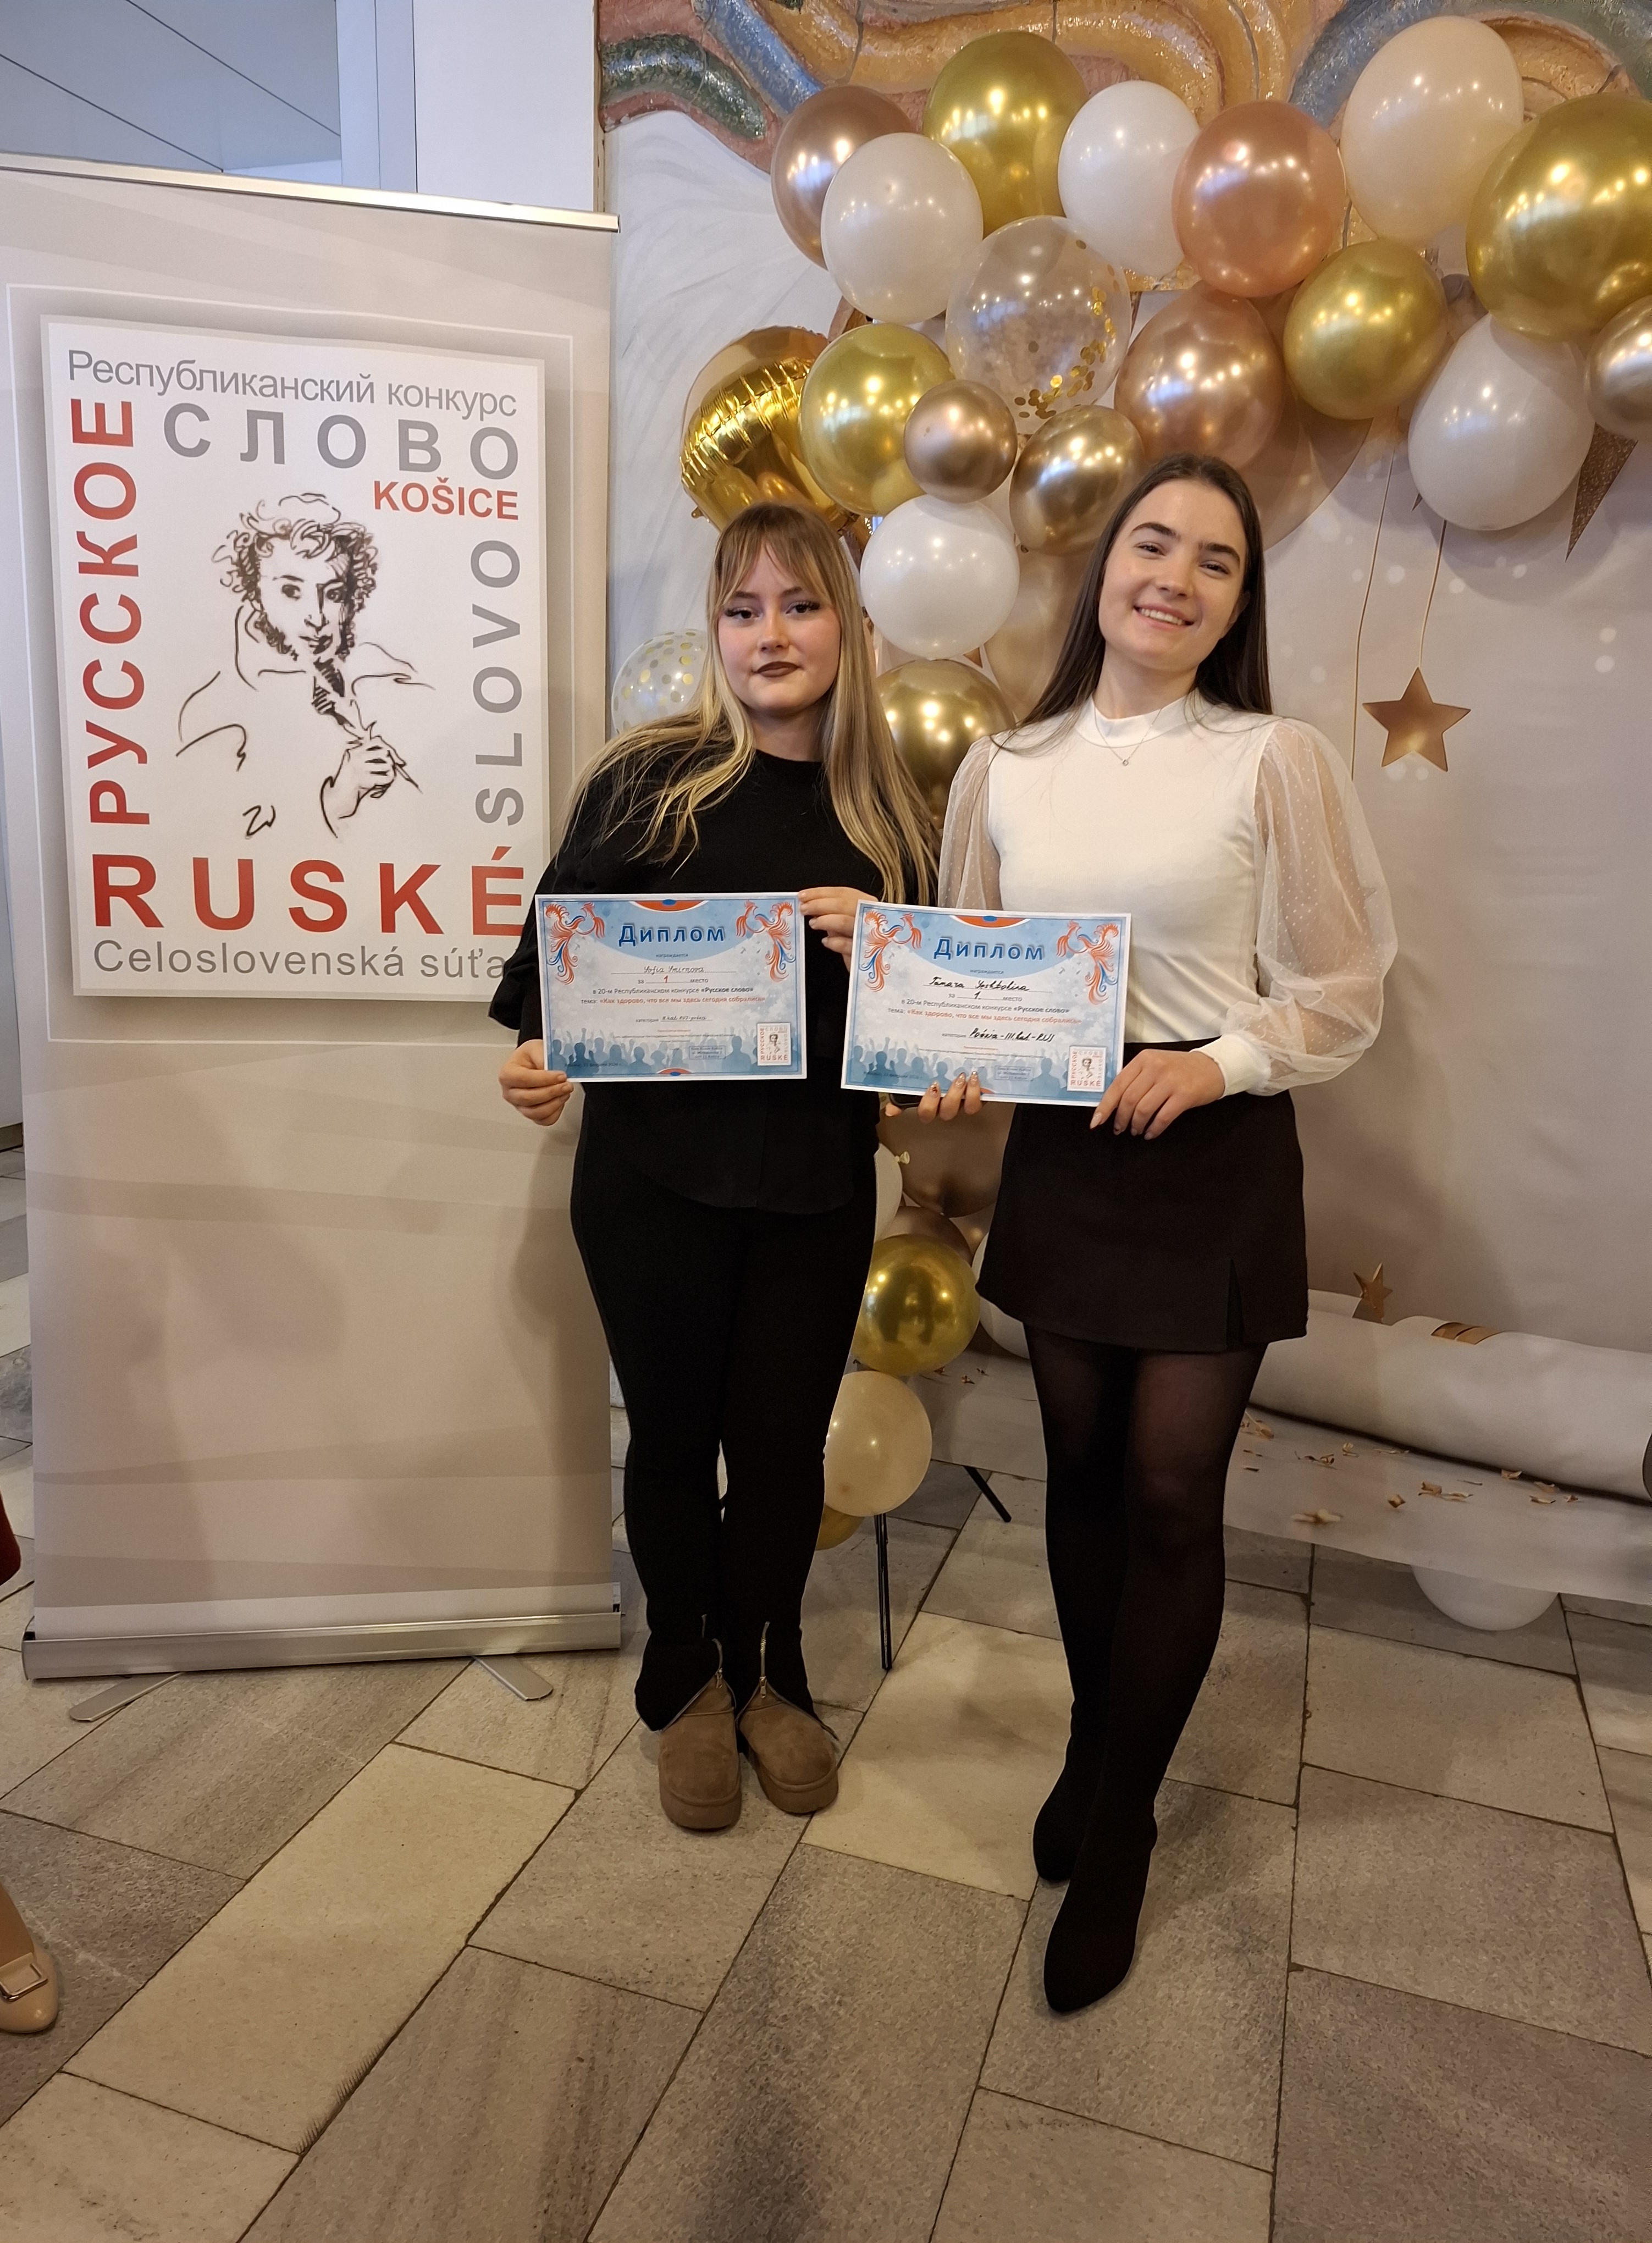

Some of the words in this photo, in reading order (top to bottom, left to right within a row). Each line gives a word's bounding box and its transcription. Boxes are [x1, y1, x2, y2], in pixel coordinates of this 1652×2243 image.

[68, 350, 375, 404] Республиканский
[388, 383, 517, 421] конкурс
[163, 403, 518, 480] СЛОВО
[373, 477, 519, 521] KOŠICE
[70, 399, 150, 825] РУССКОЕ
[471, 540, 524, 826] SLOVO
[92, 847, 524, 936] RUSKÉ
[94, 940, 404, 977] Celoslovenská
[420, 947, 518, 979] súťa
[618, 924, 725, 947] Диплом
[933, 937, 1043, 960] Диплом
